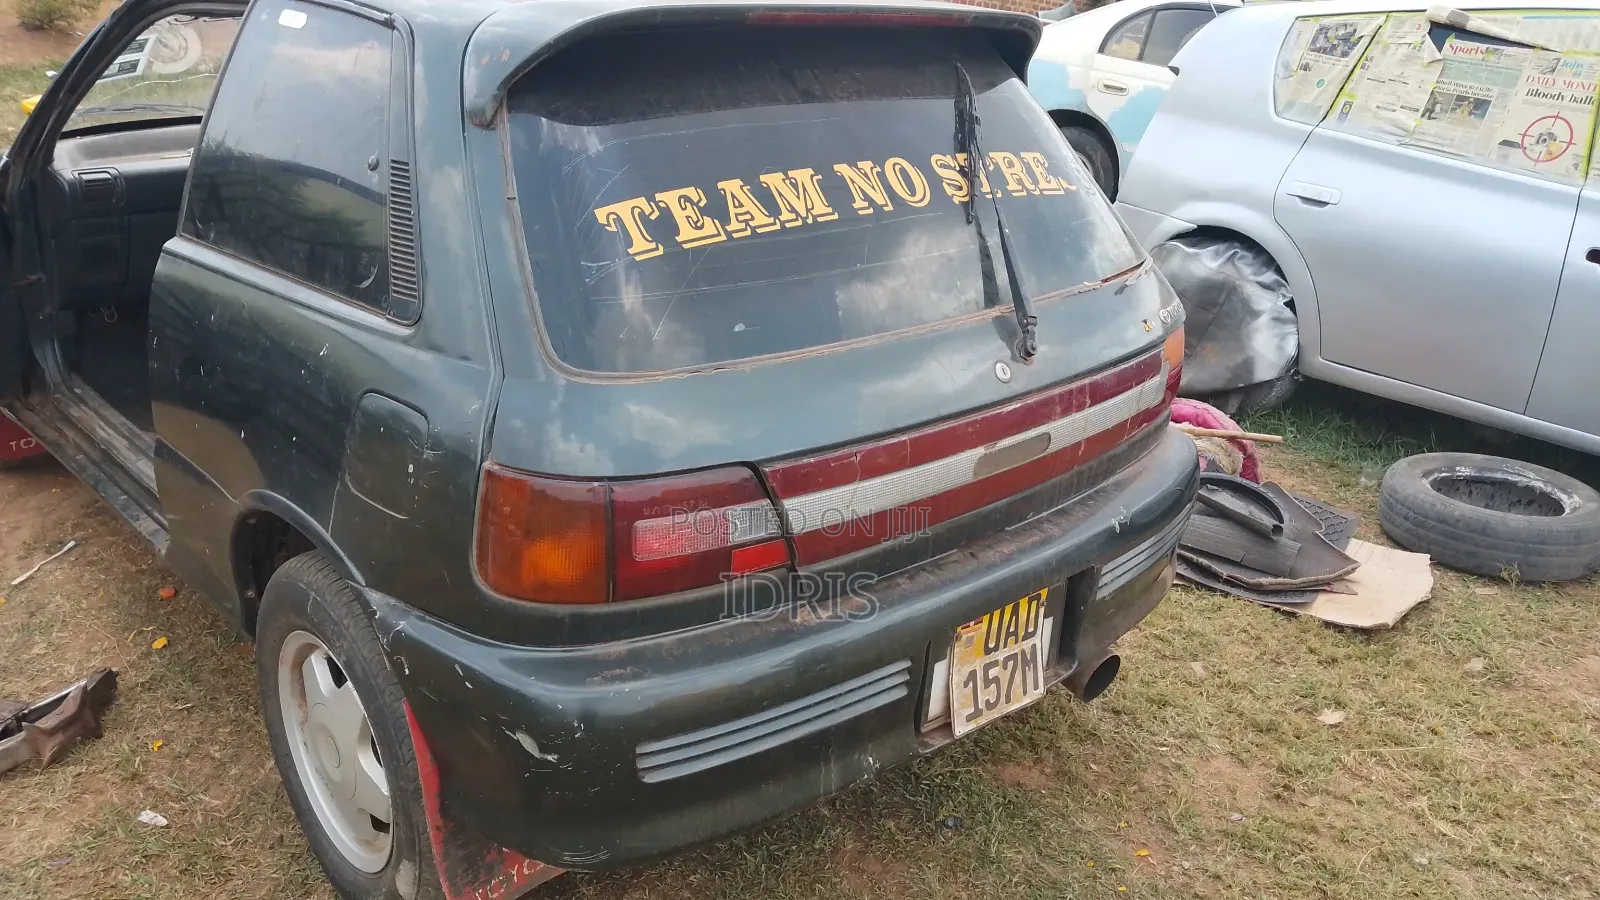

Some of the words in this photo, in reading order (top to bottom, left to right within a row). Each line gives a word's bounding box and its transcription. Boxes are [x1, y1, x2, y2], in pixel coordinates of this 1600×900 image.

[1449, 43, 1486, 56] Sports
[1525, 74, 1556, 87] DAILY
[1562, 79, 1598, 93] MONIT
[1525, 88, 1565, 102] Bloody
[594, 167, 838, 261] TEAM
[833, 157, 931, 215] NO
[983, 592, 1043, 656] UAD
[963, 643, 1039, 723] 157M
